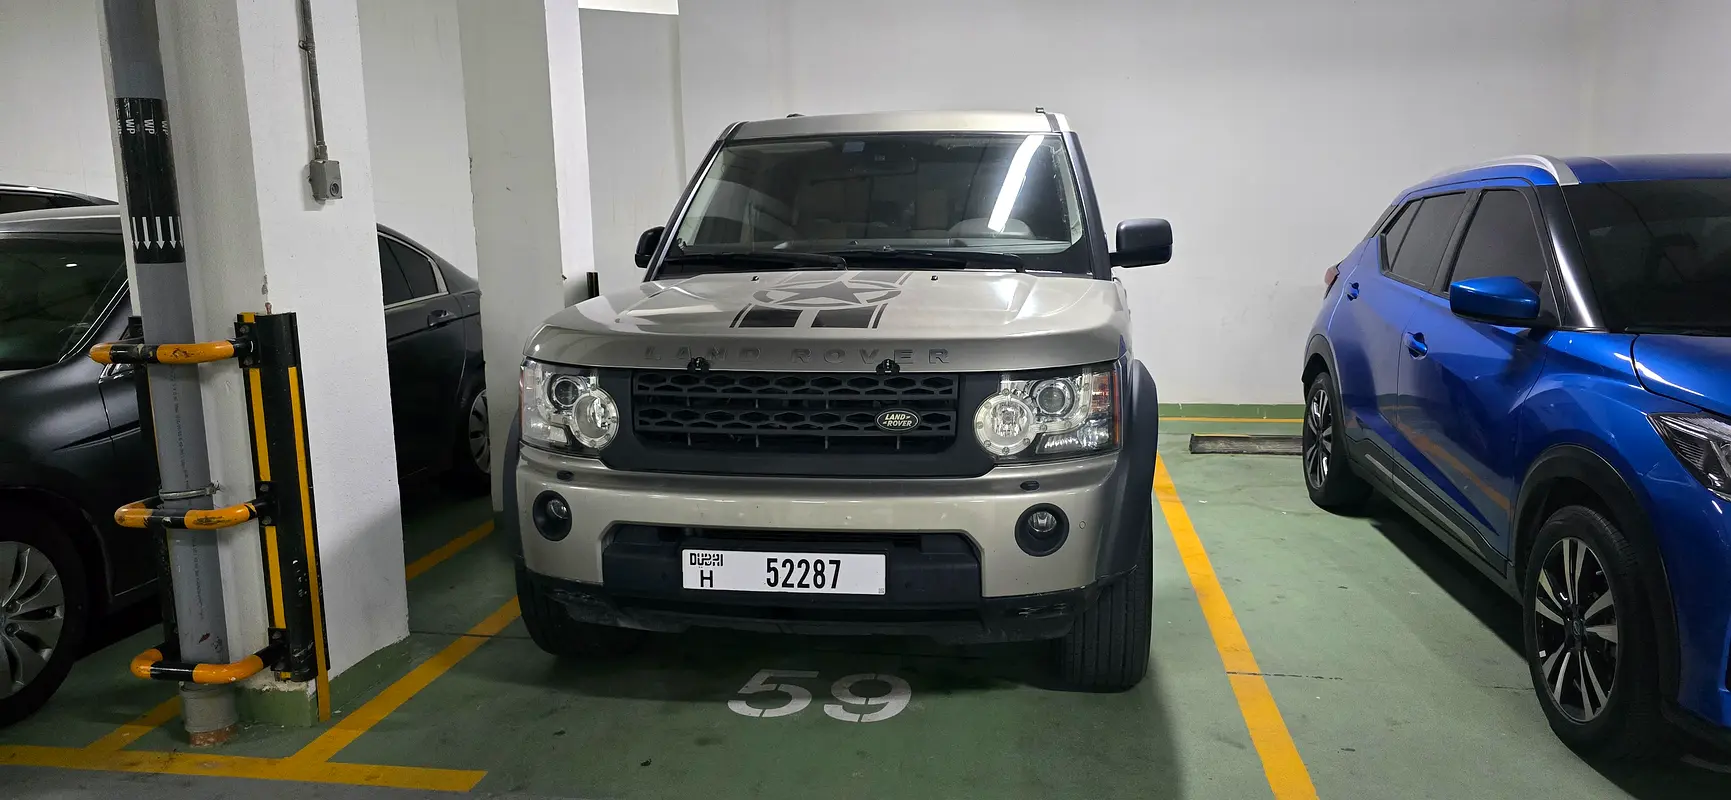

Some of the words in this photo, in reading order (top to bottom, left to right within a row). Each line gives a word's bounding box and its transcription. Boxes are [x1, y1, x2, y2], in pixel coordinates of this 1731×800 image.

[125, 118, 136, 135] WP
[144, 118, 155, 135] WP
[644, 347, 761, 363] LAND
[791, 348, 950, 364] ROVER
[884, 413, 906, 421] LAND
[700, 569, 713, 588] H
[766, 557, 841, 590] 52287
[727, 669, 912, 723] 59
